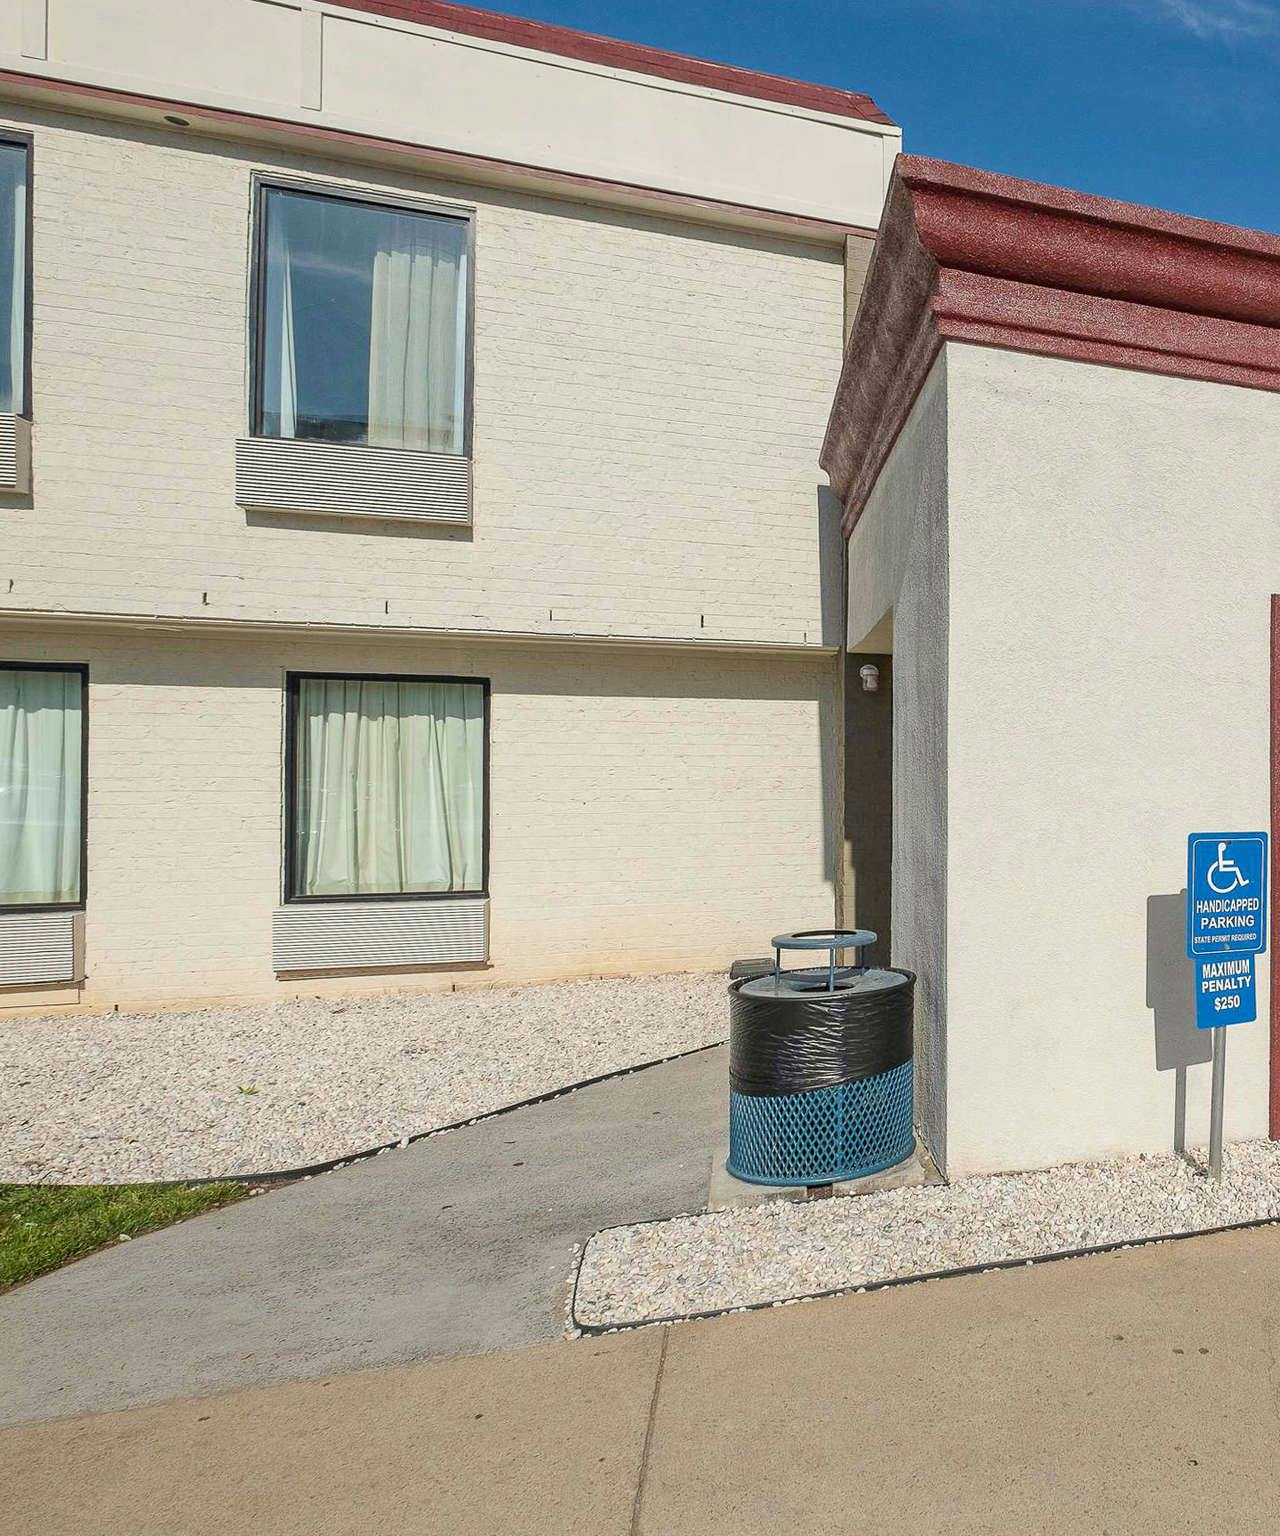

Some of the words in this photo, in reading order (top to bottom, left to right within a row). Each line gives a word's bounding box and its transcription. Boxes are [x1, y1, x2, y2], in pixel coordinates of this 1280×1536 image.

[1196, 898, 1259, 914] HANDICAPPED
[1201, 915, 1255, 929] PARKING
[1194, 936, 1211, 944] STATE
[1212, 934, 1231, 943] PERMIT
[1231, 933, 1257, 942] REQUIRED
[1202, 959, 1250, 979] MAXIMUM
[1202, 976, 1251, 993] PENALTY
[1214, 995, 1240, 1012] $250
